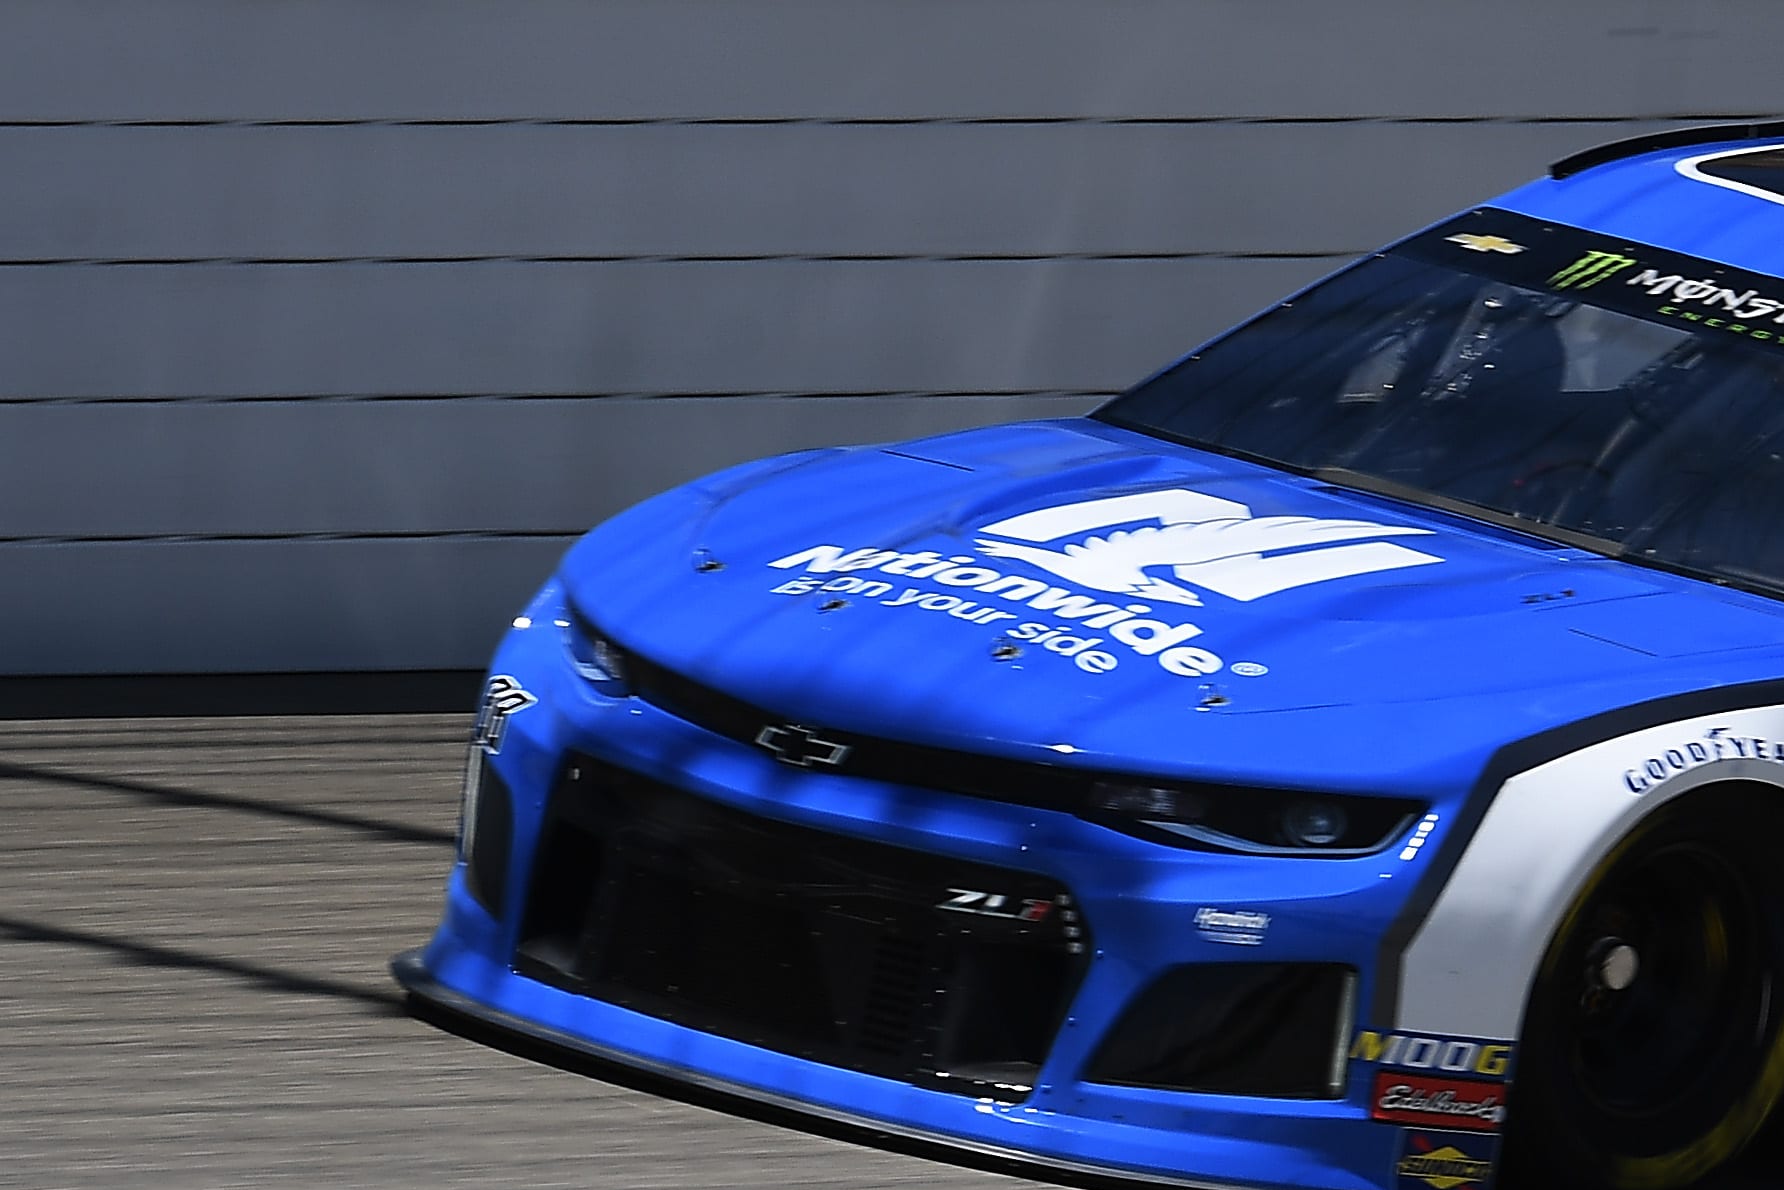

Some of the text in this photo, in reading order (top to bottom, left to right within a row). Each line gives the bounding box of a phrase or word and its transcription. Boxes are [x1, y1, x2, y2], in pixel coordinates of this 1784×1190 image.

[766, 544, 1224, 677] Nationwide
[820, 576, 894, 598] on
[879, 588, 1018, 625] your
[1006, 620, 1118, 674] side
[1349, 1031, 1512, 1075] MOOG
